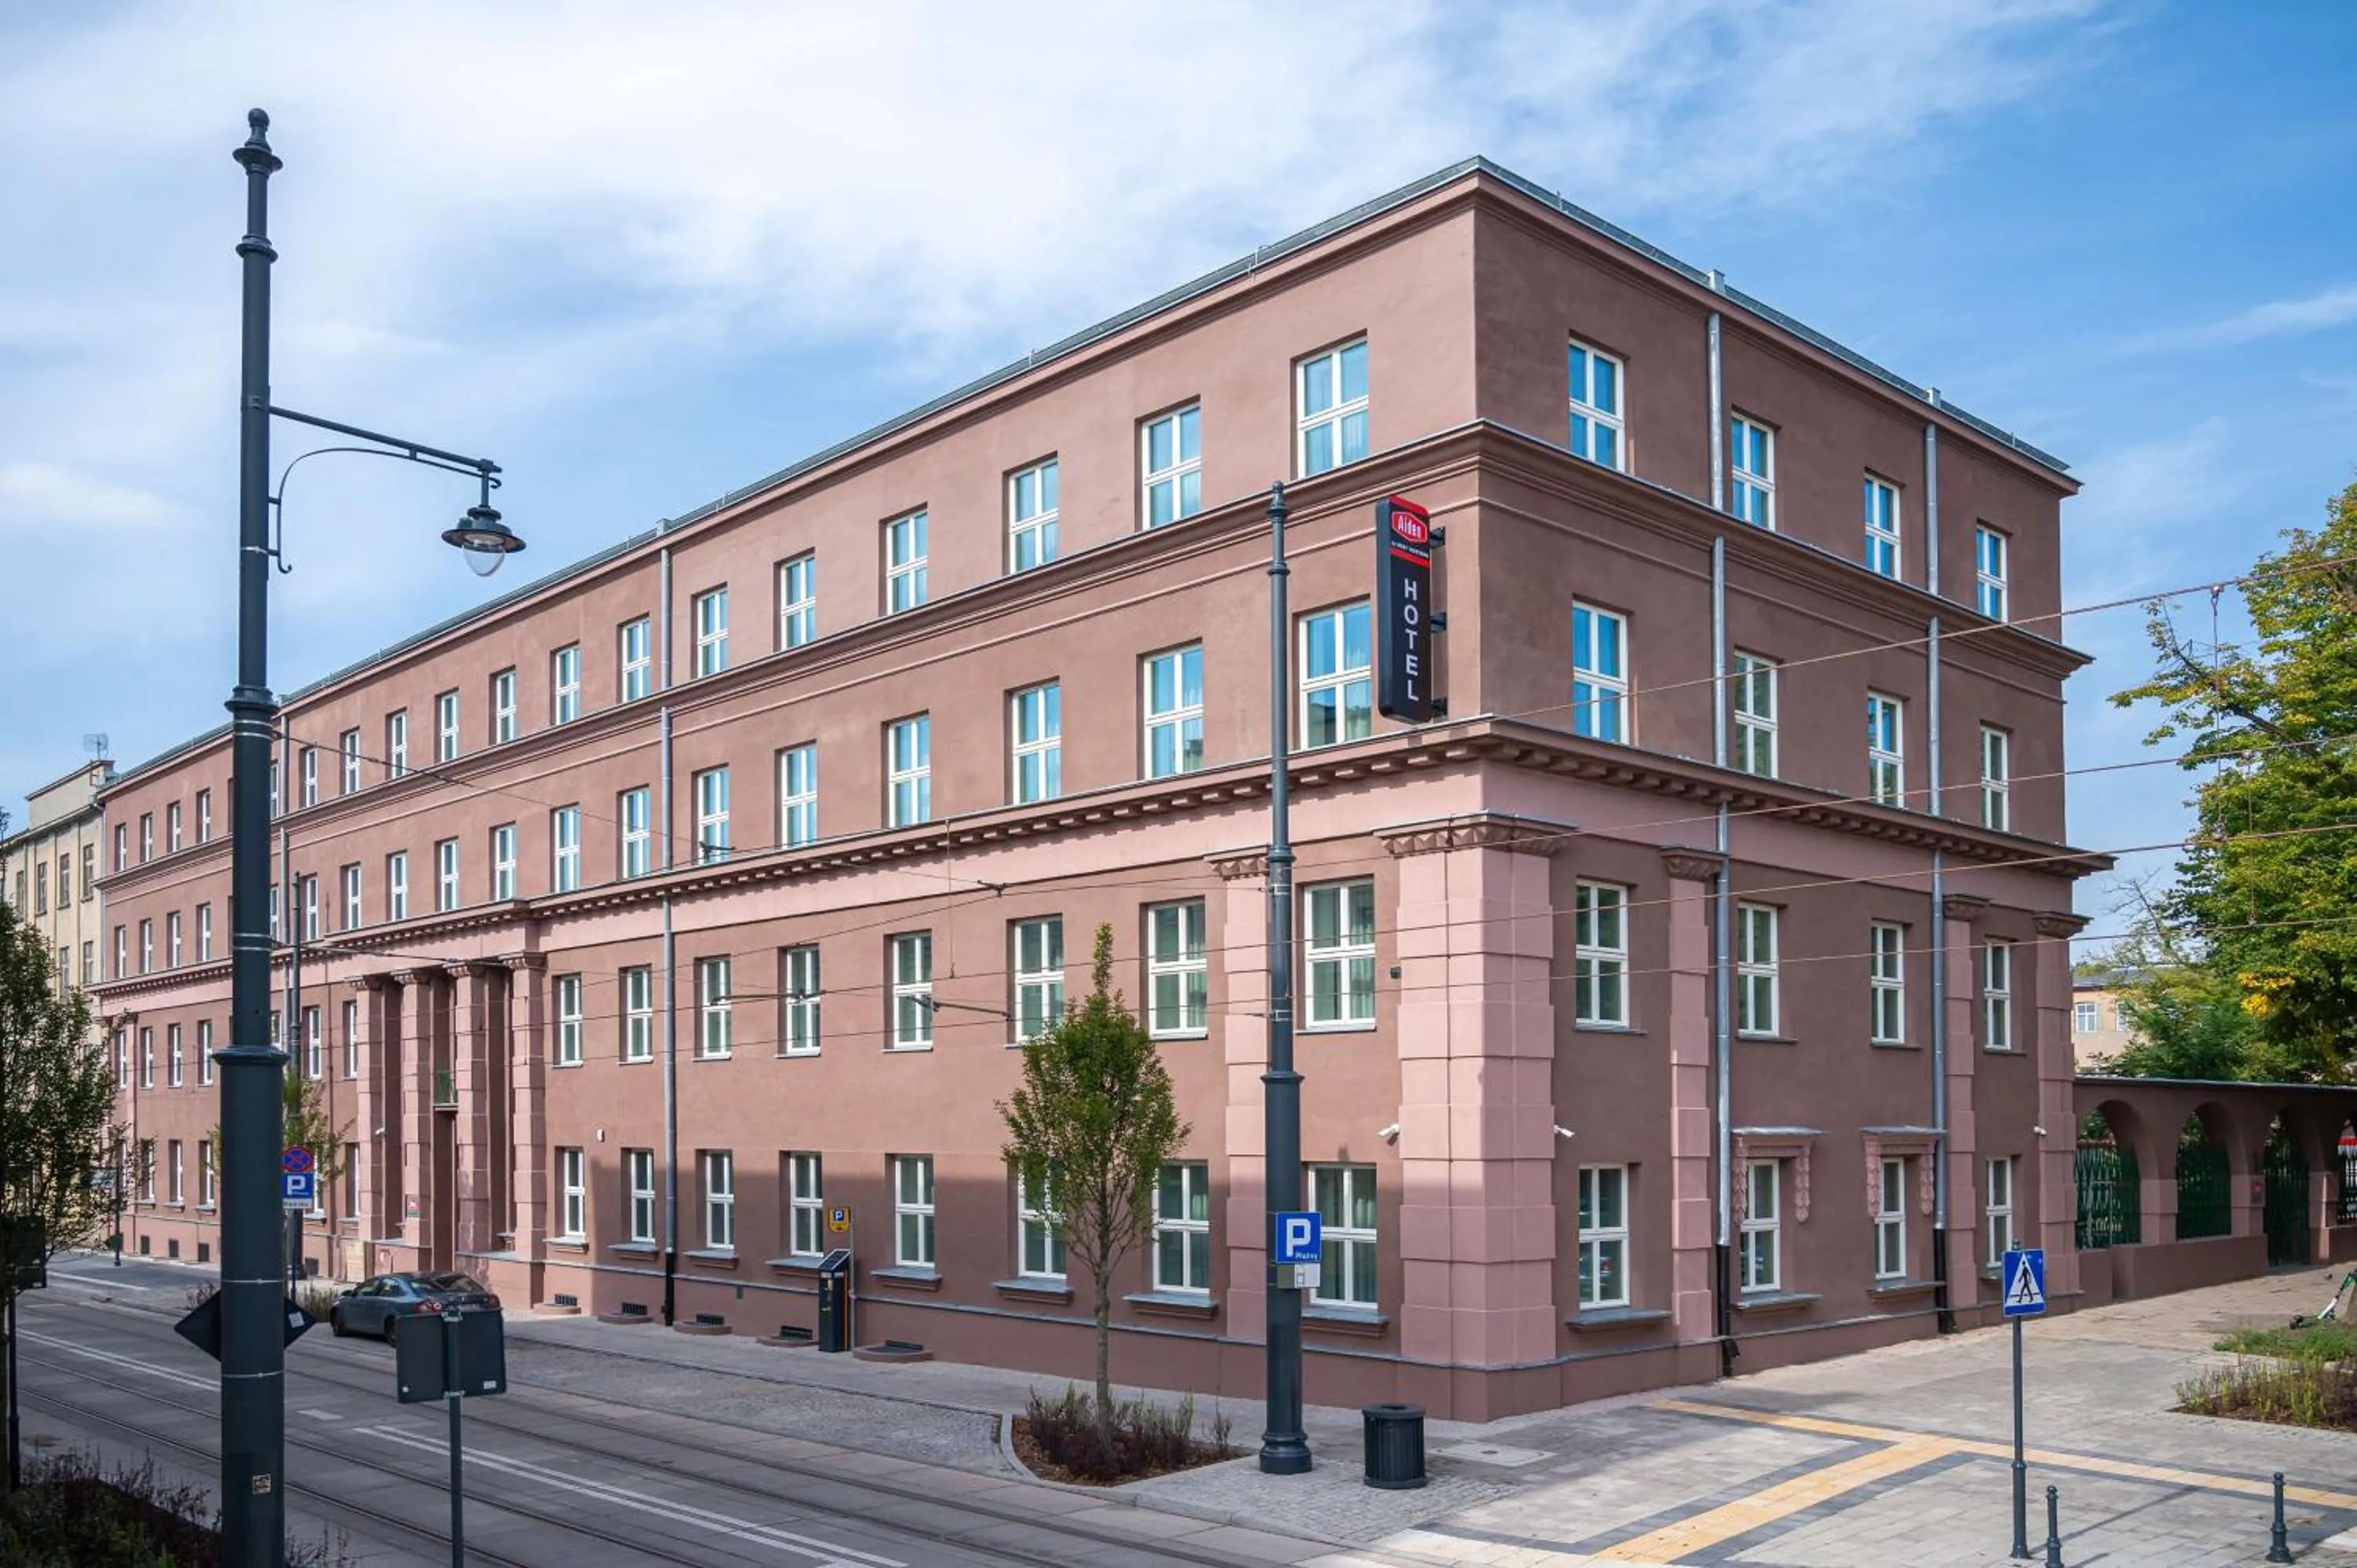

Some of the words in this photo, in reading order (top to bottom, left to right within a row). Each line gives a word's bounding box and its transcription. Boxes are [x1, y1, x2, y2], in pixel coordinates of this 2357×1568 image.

[1403, 577, 1419, 702] HOTEL
[287, 1174, 306, 1195] P
[835, 1211, 843, 1220] P
[1286, 1218, 1311, 1258] P
